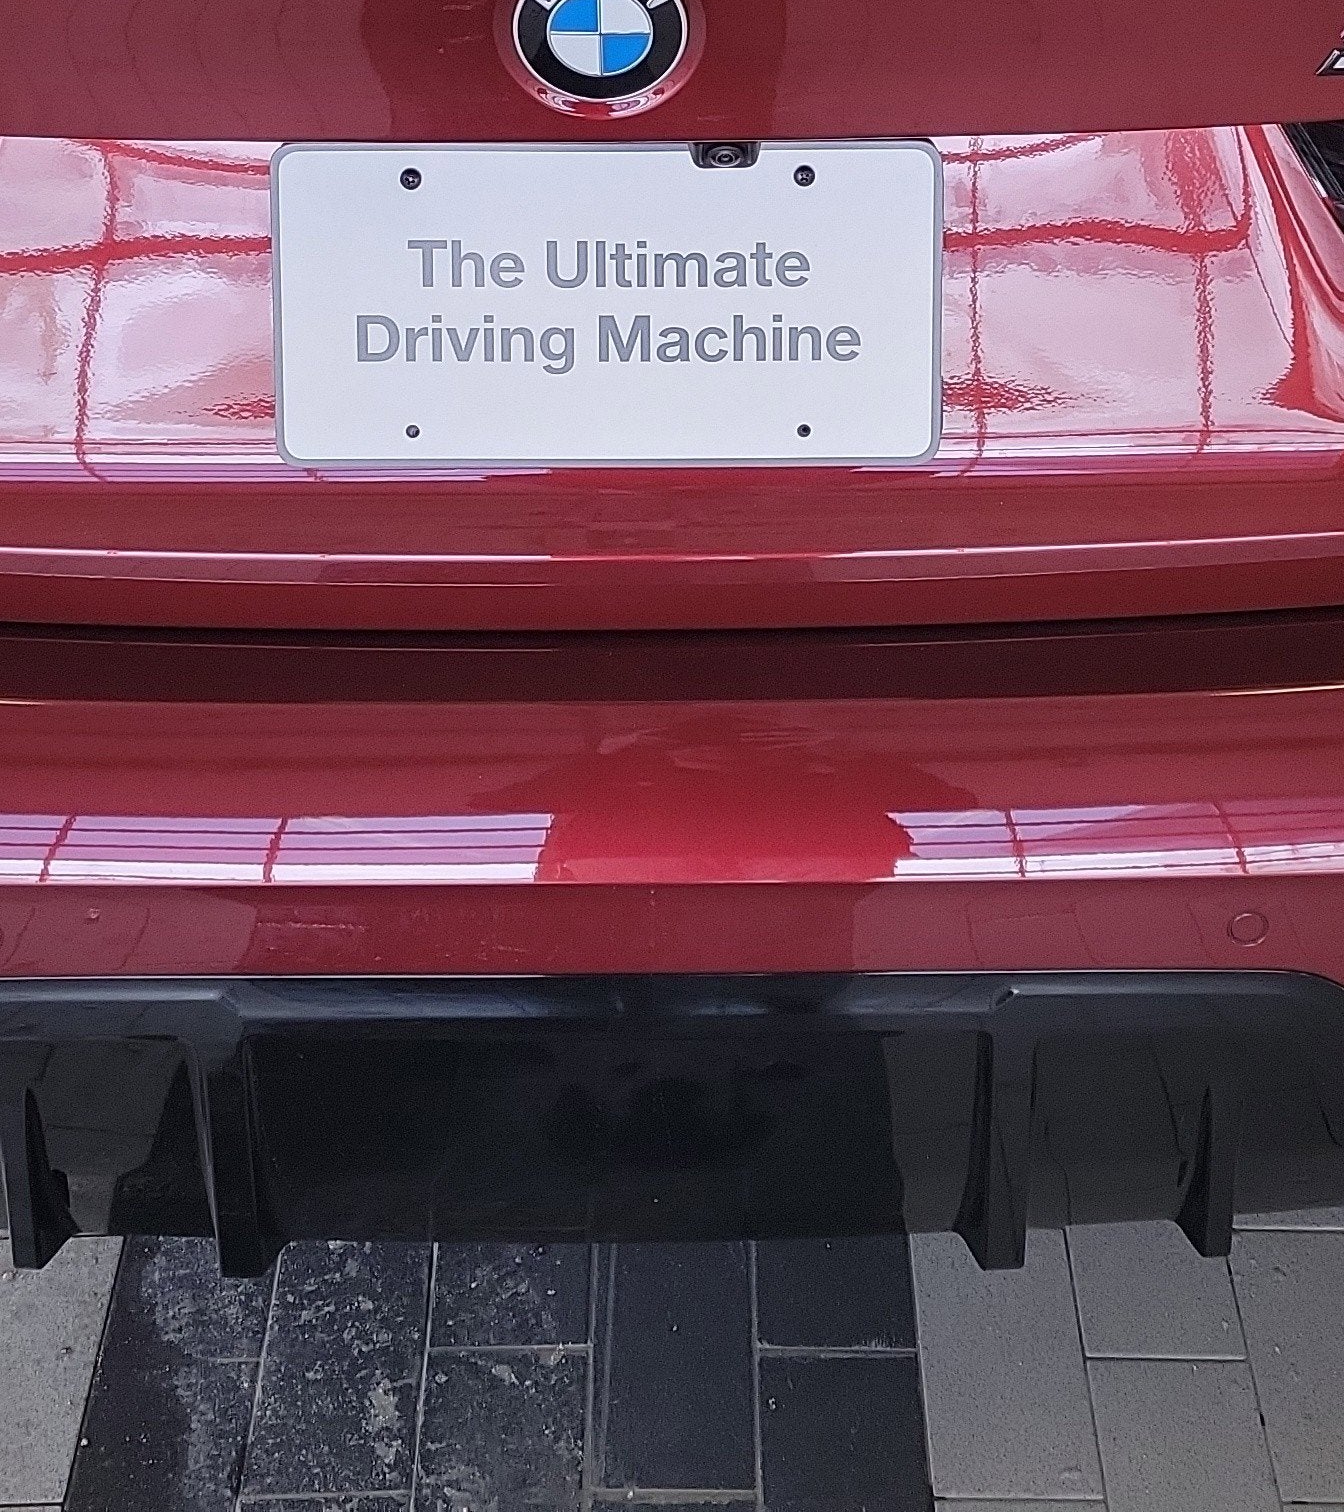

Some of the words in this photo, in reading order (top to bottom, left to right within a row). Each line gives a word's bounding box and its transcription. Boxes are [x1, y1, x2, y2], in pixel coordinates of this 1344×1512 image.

[407, 239, 525, 289] The
[545, 239, 811, 289] Ultimate
[356, 314, 576, 374] Driving
[598, 314, 862, 363] Machine
